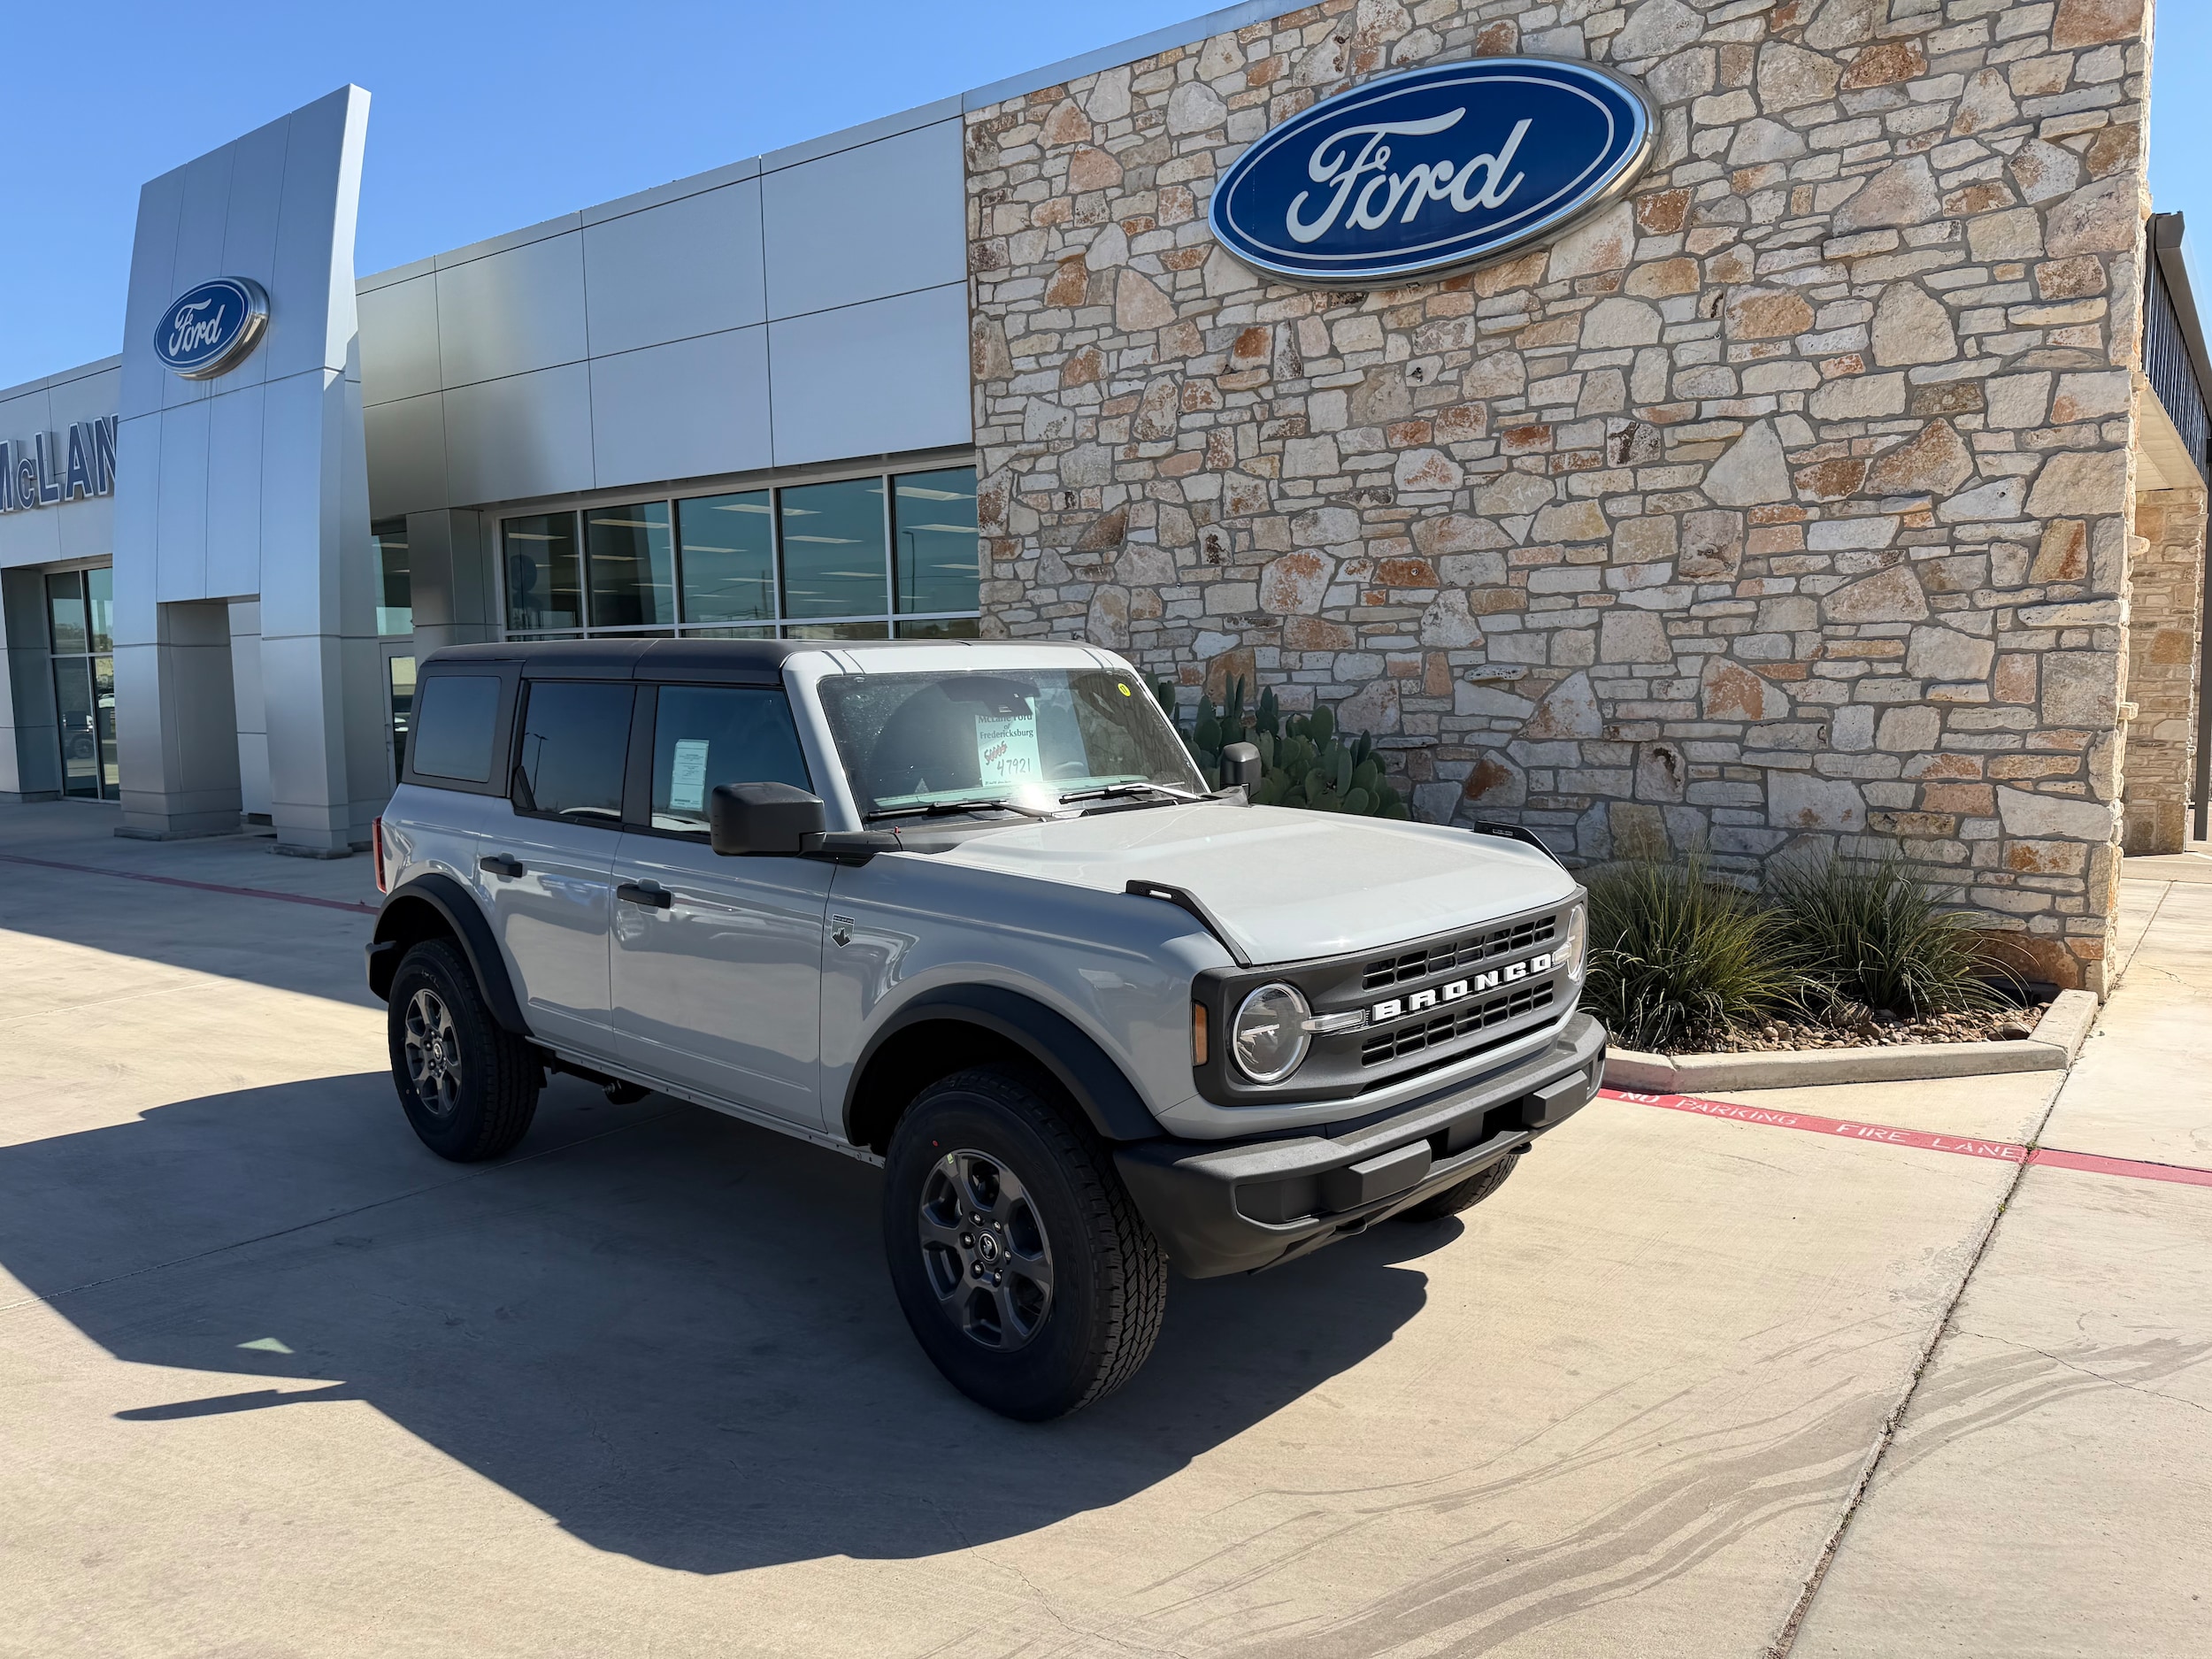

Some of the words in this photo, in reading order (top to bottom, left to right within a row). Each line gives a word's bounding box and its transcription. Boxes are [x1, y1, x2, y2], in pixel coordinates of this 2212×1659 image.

[1286, 106, 1533, 243] Ford
[168, 298, 226, 357] Ford
[979, 728, 1034, 740] Fredericksburg
[996, 757, 1031, 777] 47921
[1372, 953, 1552, 1021] BRONCO
[1619, 1092, 1661, 1104] NO
[1675, 1099, 1798, 1125] PARKING
[1836, 1124, 1911, 1143] FIRE
[1932, 1137, 2024, 1160] LANE
